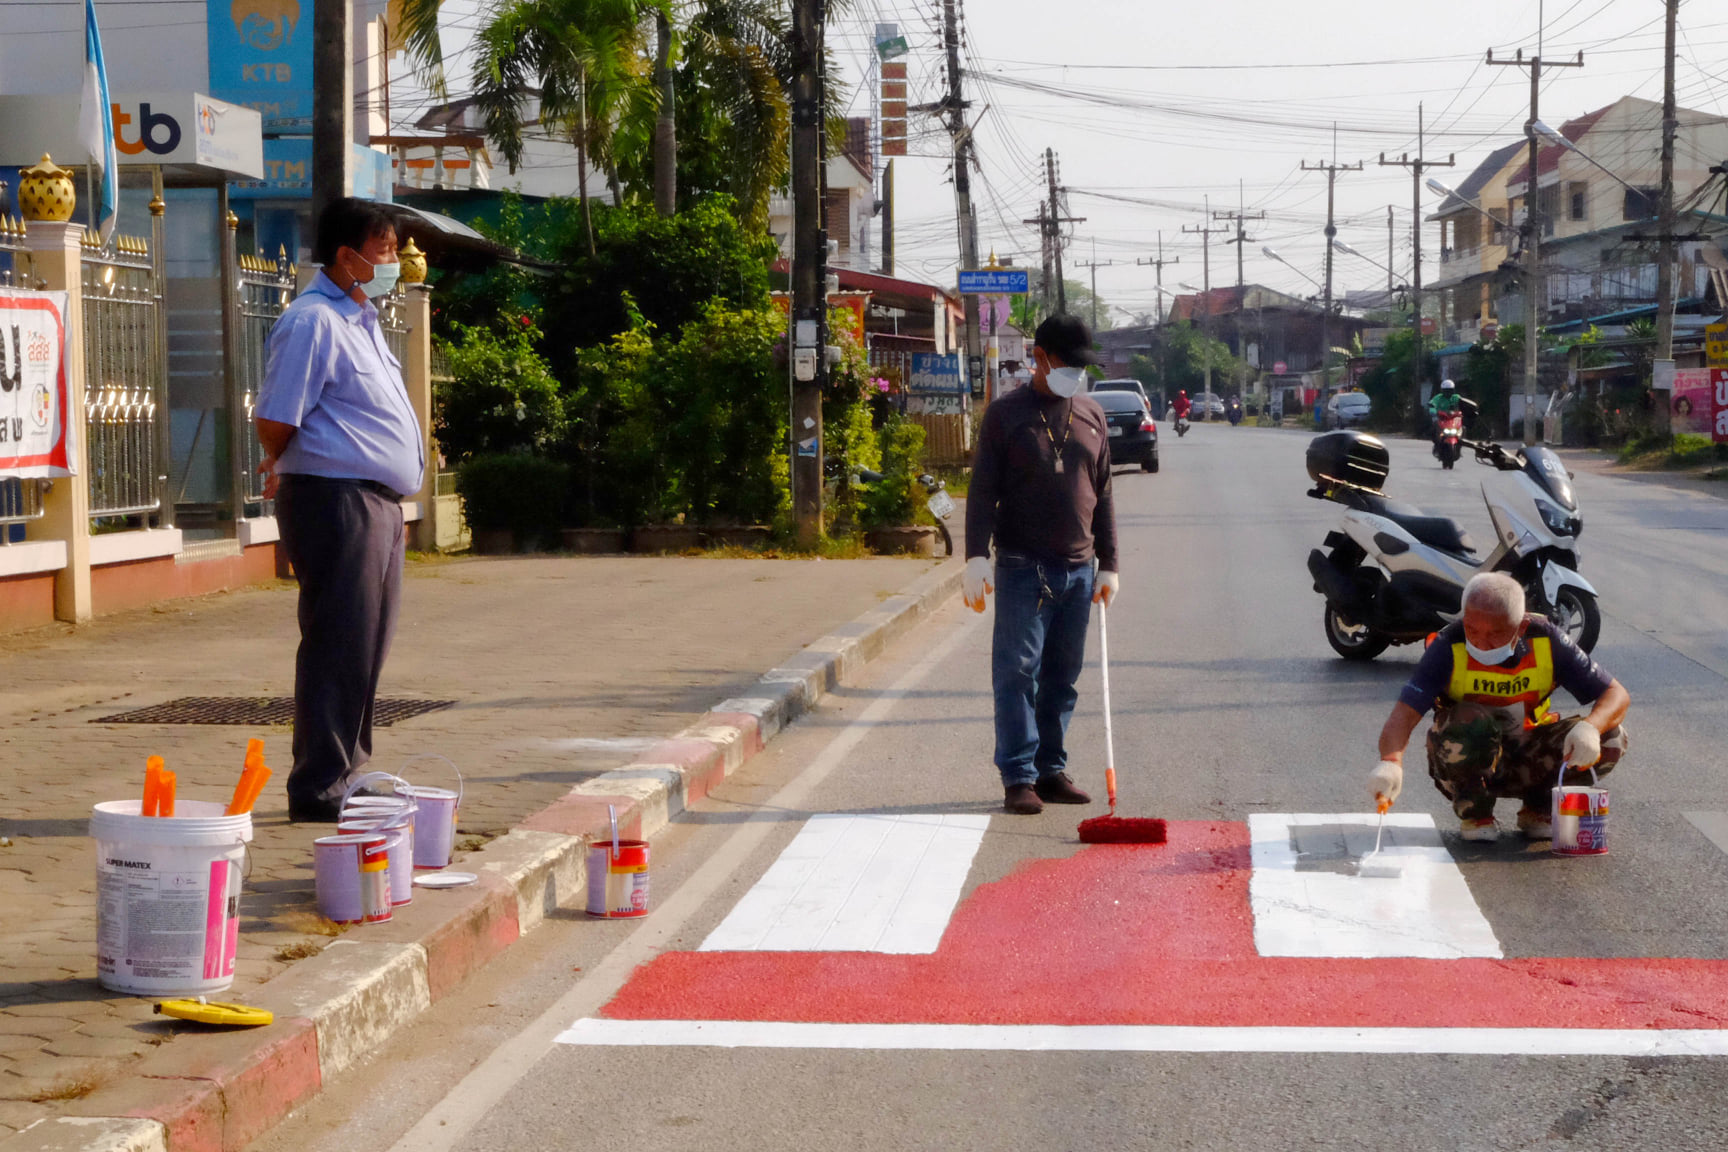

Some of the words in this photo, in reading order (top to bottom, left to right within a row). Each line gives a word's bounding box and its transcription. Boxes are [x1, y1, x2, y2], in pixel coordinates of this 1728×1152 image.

[242, 63, 291, 82] KTB
[111, 103, 181, 155] tb
[264, 160, 305, 179] TM
[1009, 274, 1026, 285] 5/2
[1474, 676, 1530, 694] เทศกิจ
[105, 857, 124, 867] SUPER
[124, 860, 152, 870] MATEX
